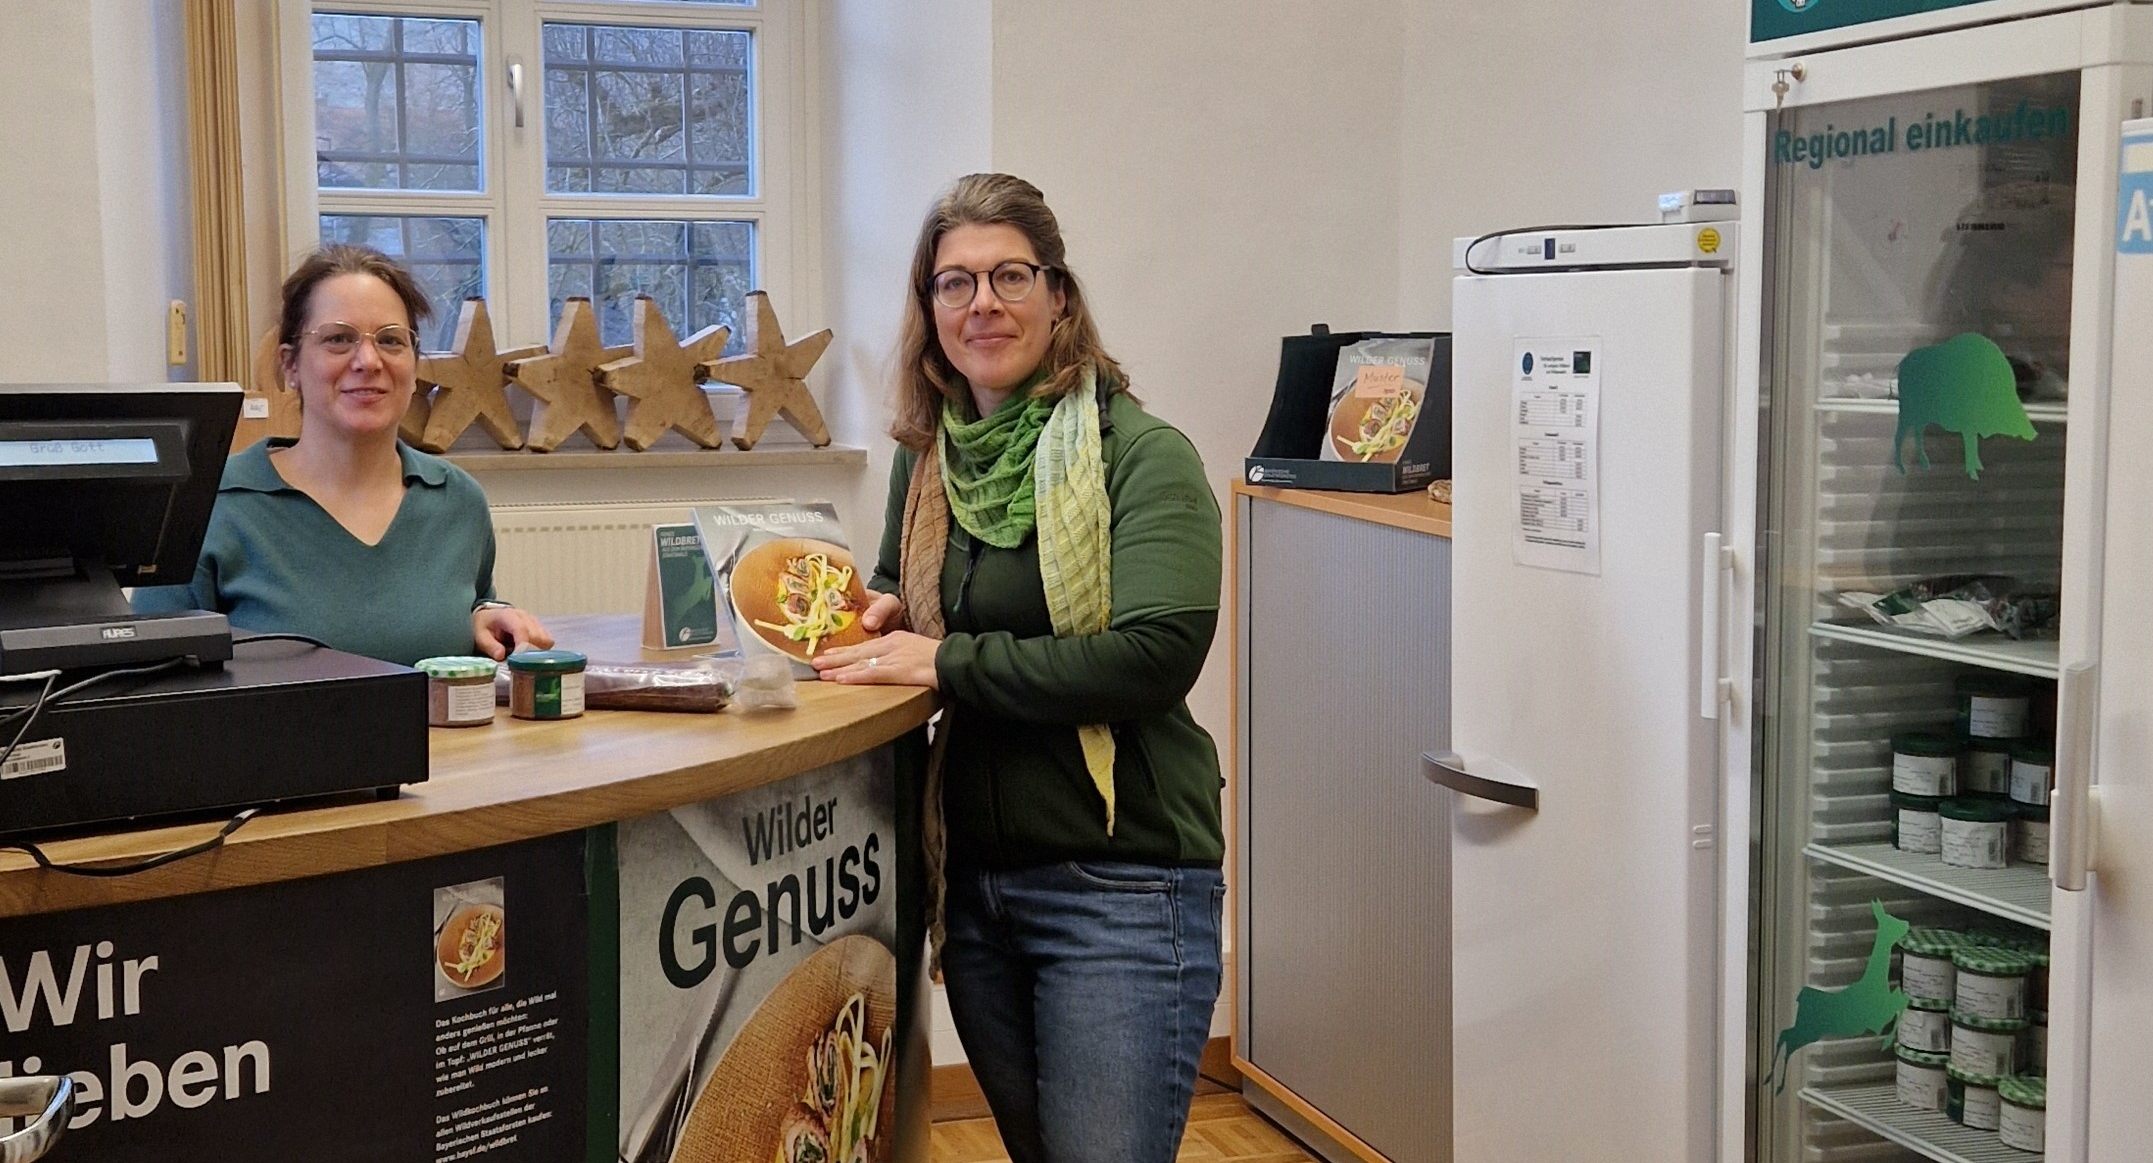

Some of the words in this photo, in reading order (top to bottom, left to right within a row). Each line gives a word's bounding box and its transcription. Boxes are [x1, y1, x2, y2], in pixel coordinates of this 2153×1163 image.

[1774, 117, 1896, 169] Regional
[1906, 101, 2068, 151] einkaufen
[2121, 188, 2153, 242] A
[1350, 354, 1384, 365] WILDER
[1387, 356, 1426, 366] GENUSS
[1363, 371, 1400, 384] Muster
[71, 442, 104, 453] Gott
[713, 512, 765, 526] WILDER
[769, 511, 824, 524] GENUSS
[742, 795, 837, 866] Wilder
[659, 832, 881, 989] Genuss
[0, 940, 159, 1033] Wir
[435, 1018, 450, 1028] Das
[451, 1010, 488, 1024] Kochbuch
[488, 1006, 499, 1015] für
[528, 994, 543, 1005] Wild
[544, 990, 557, 1001] mal
[435, 1030, 461, 1042] anders
[462, 1022, 495, 1037] genießen
[435, 1046, 447, 1056] Ob
[448, 1042, 461, 1053] auf
[462, 1039, 477, 1049] dem
[497, 1032, 504, 1040] in
[505, 1028, 517, 1038] der
[518, 1023, 542, 1034] Pfanne
[543, 1018, 559, 1028] oder
[435, 1073, 449, 1083] wie
[450, 1069, 467, 1080] man
[468, 1063, 484, 1075] Wild
[485, 1056, 512, 1070] modern
[512, 1051, 526, 1062] und
[527, 1046, 548, 1058] lecker
[435, 1060, 446, 1070] im
[435, 1080, 475, 1098] zubereitet.
[435, 1115, 450, 1125] Das
[451, 1098, 501, 1119] Wildkochbuch
[523, 1103, 536, 1112] der
[435, 1133, 480, 1152] Bayerischen
[480, 1120, 527, 1138] Staatsforsten
